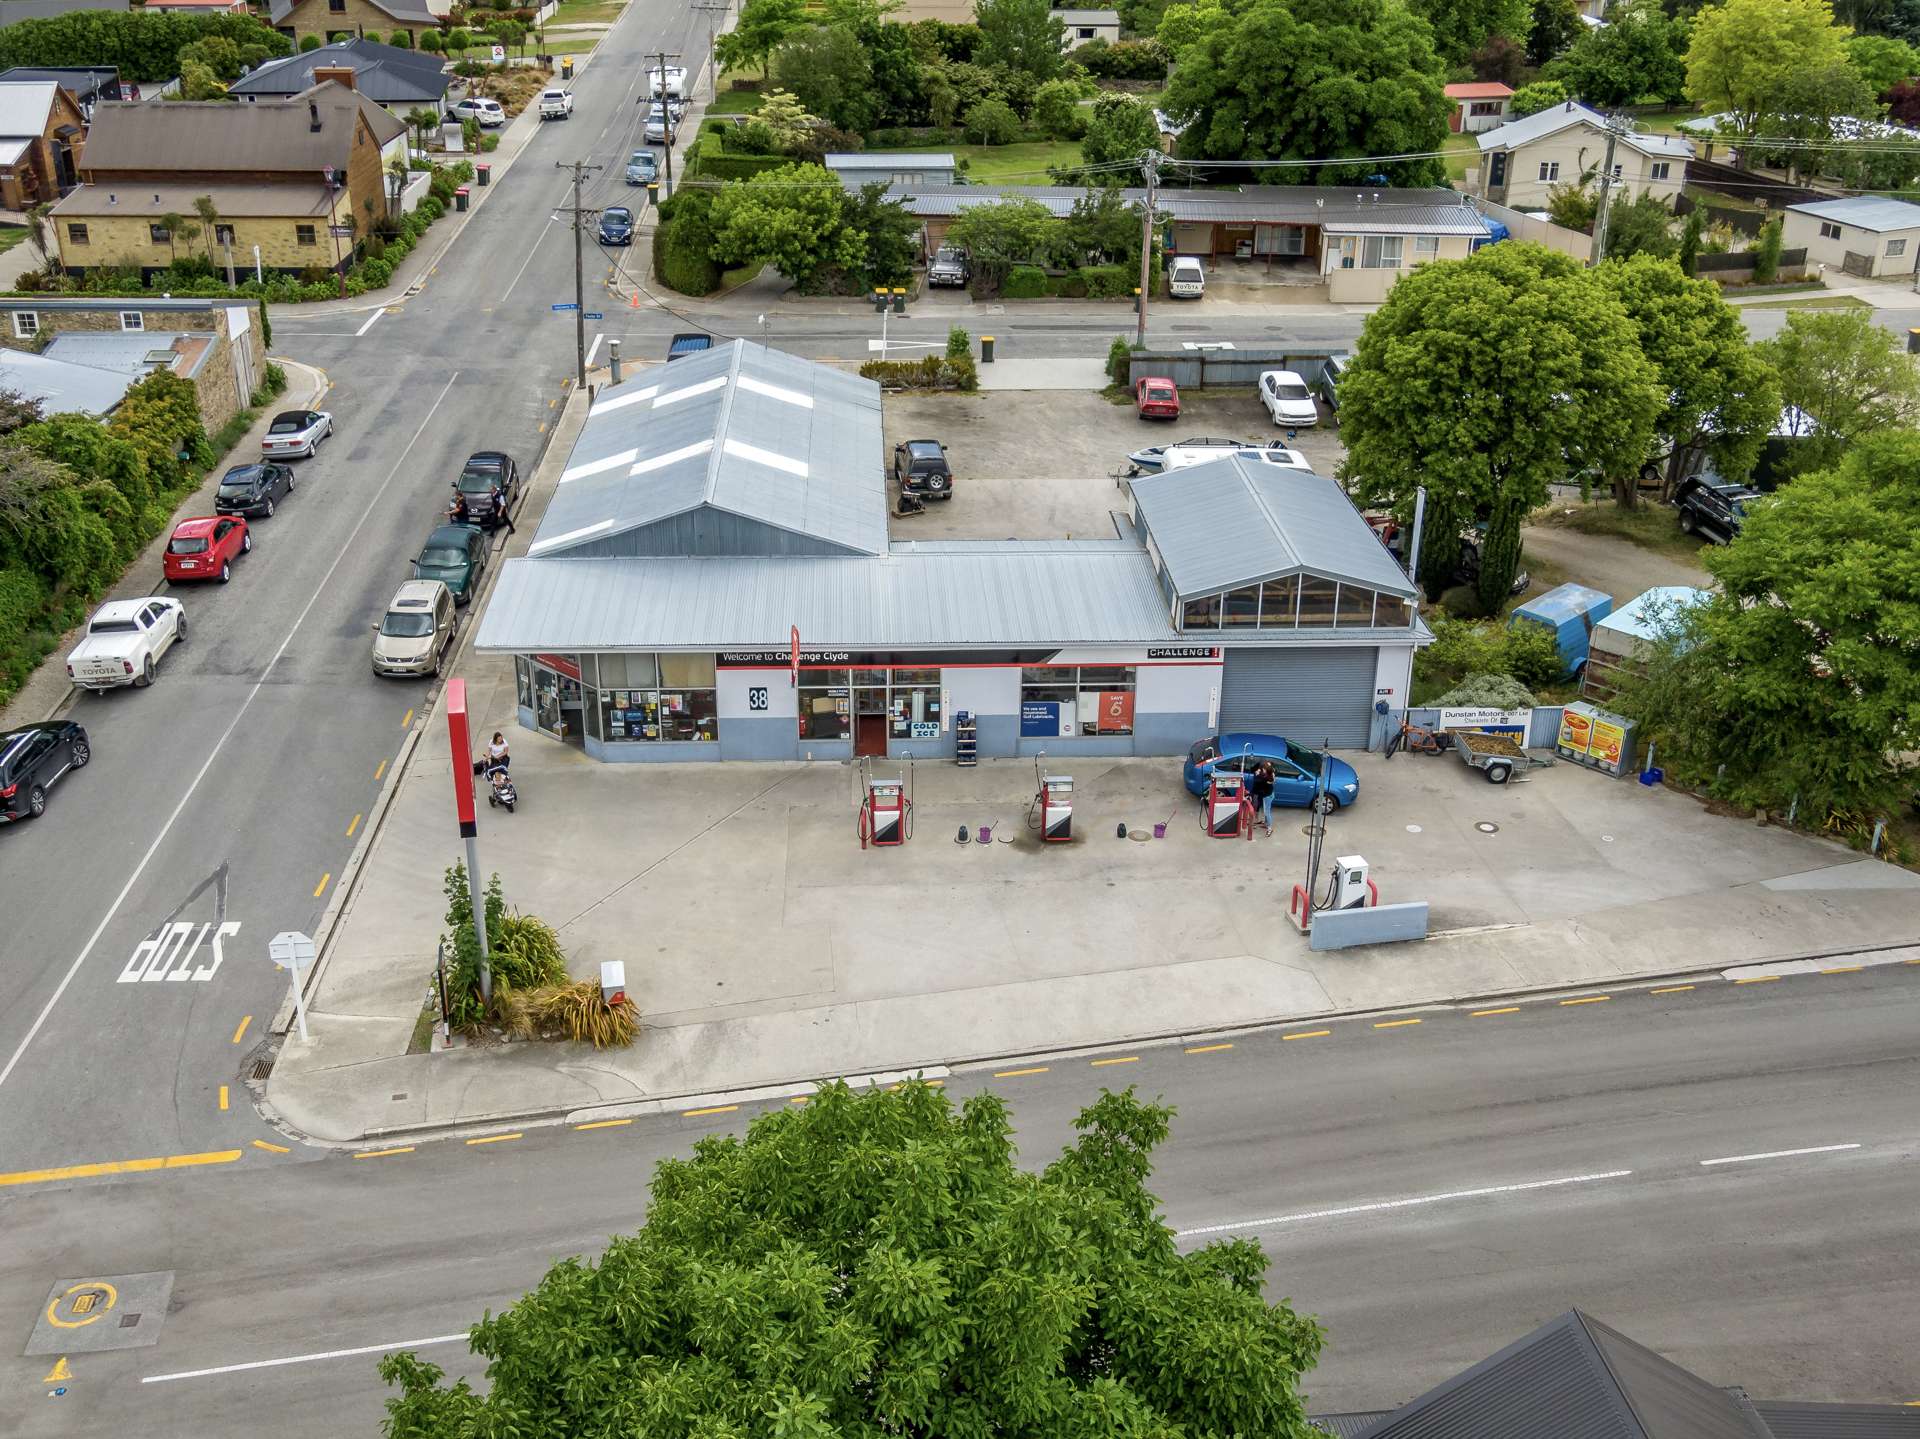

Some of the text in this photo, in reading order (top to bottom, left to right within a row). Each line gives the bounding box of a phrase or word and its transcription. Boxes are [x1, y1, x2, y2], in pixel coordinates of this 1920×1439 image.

[723, 652, 849, 662] Welcome to Chaenge Clyde
[80, 667, 117, 676] TOYOTA
[750, 689, 768, 709] 38
[116, 921, 242, 983] STOP
